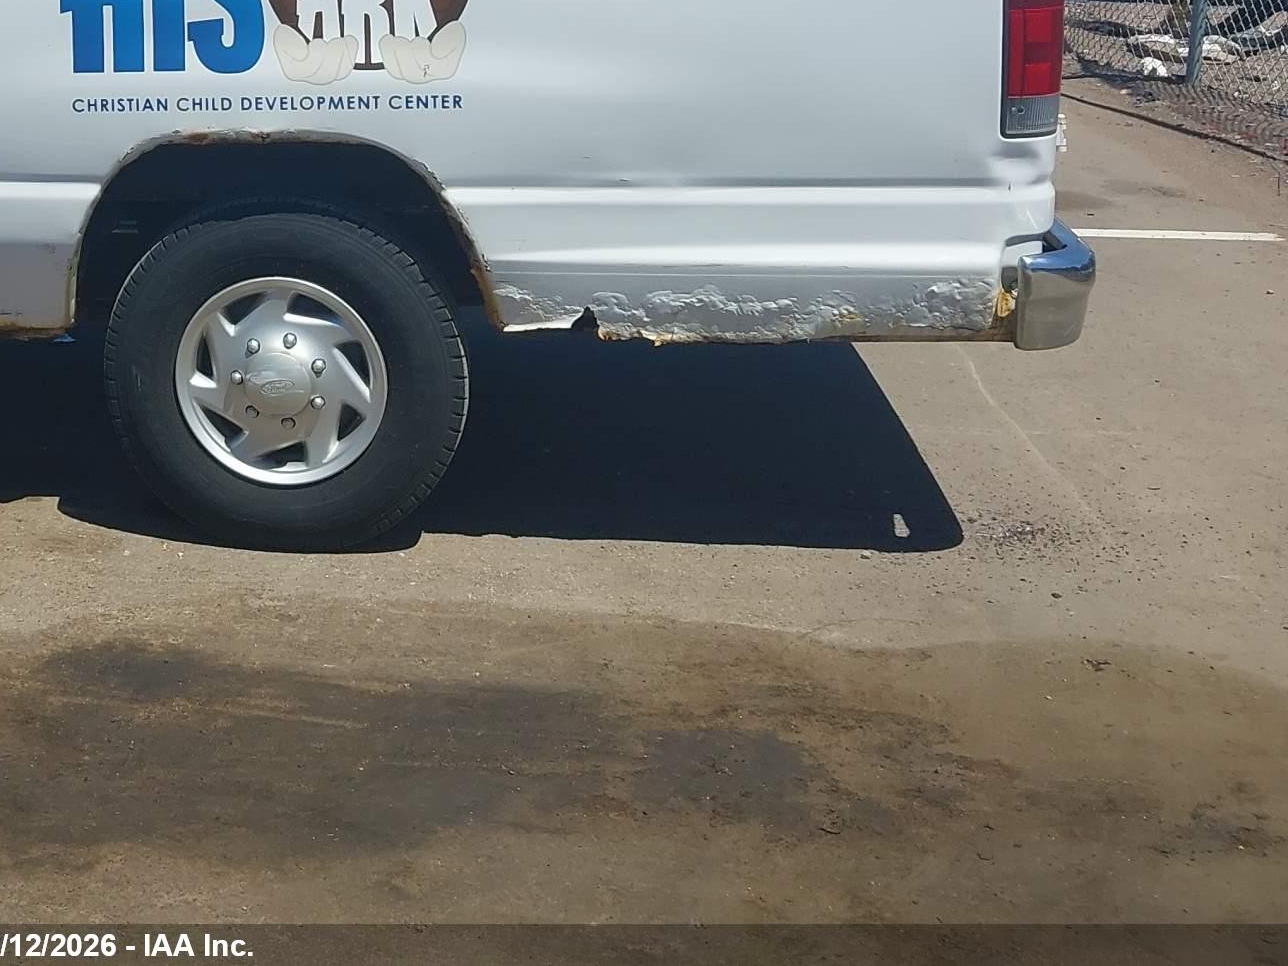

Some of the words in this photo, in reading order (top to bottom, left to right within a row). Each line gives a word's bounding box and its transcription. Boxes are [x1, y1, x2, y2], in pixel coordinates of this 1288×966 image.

[72, 98, 168, 112] CHRISTIAN
[176, 97, 232, 111] CHILD
[240, 95, 380, 111] DEVELOPMENT
[388, 94, 463, 110] CENTER
